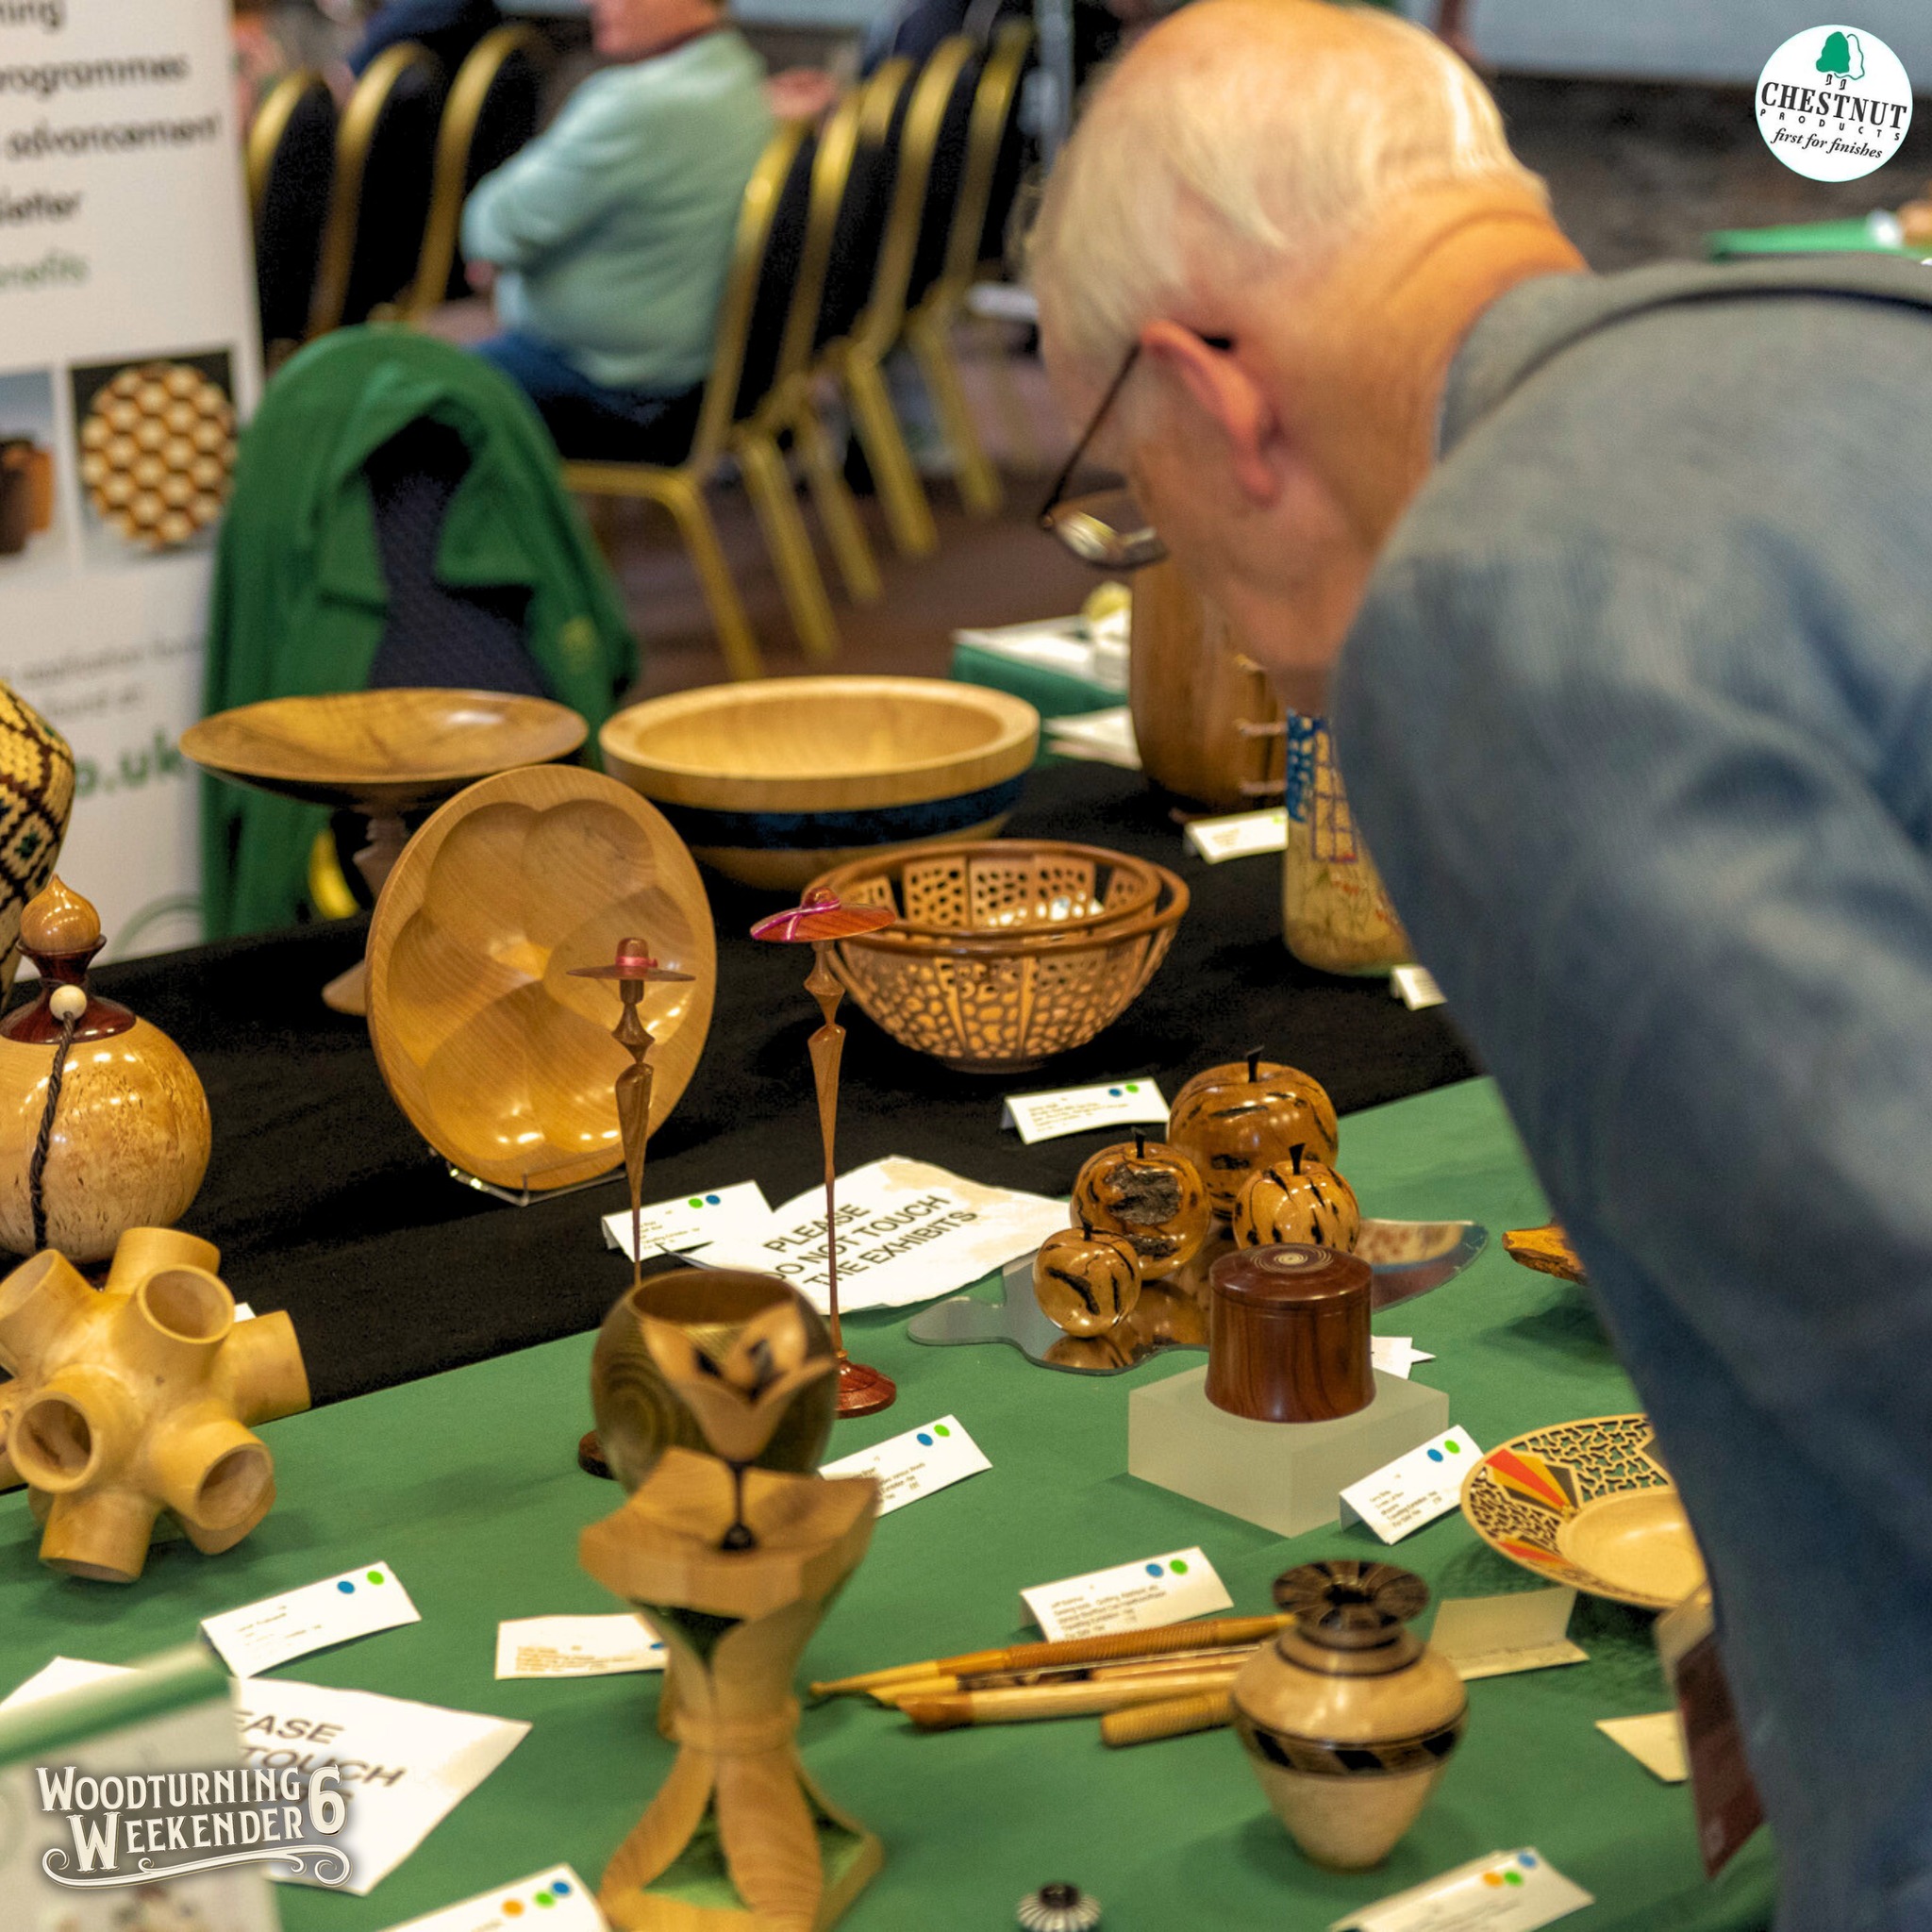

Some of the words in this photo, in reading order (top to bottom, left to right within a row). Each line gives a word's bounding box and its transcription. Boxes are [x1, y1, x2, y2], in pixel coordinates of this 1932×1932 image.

[0, 0, 64, 32] ing
[0, 191, 80, 225] letter
[763, 1204, 871, 1253] PLEASE
[767, 1262, 805, 1280] O
[797, 1235, 860, 1265] NOT
[852, 1195, 951, 1238] TOUCH
[803, 1260, 870, 1286] THE
[858, 1211, 978, 1264] EXHIBITS
